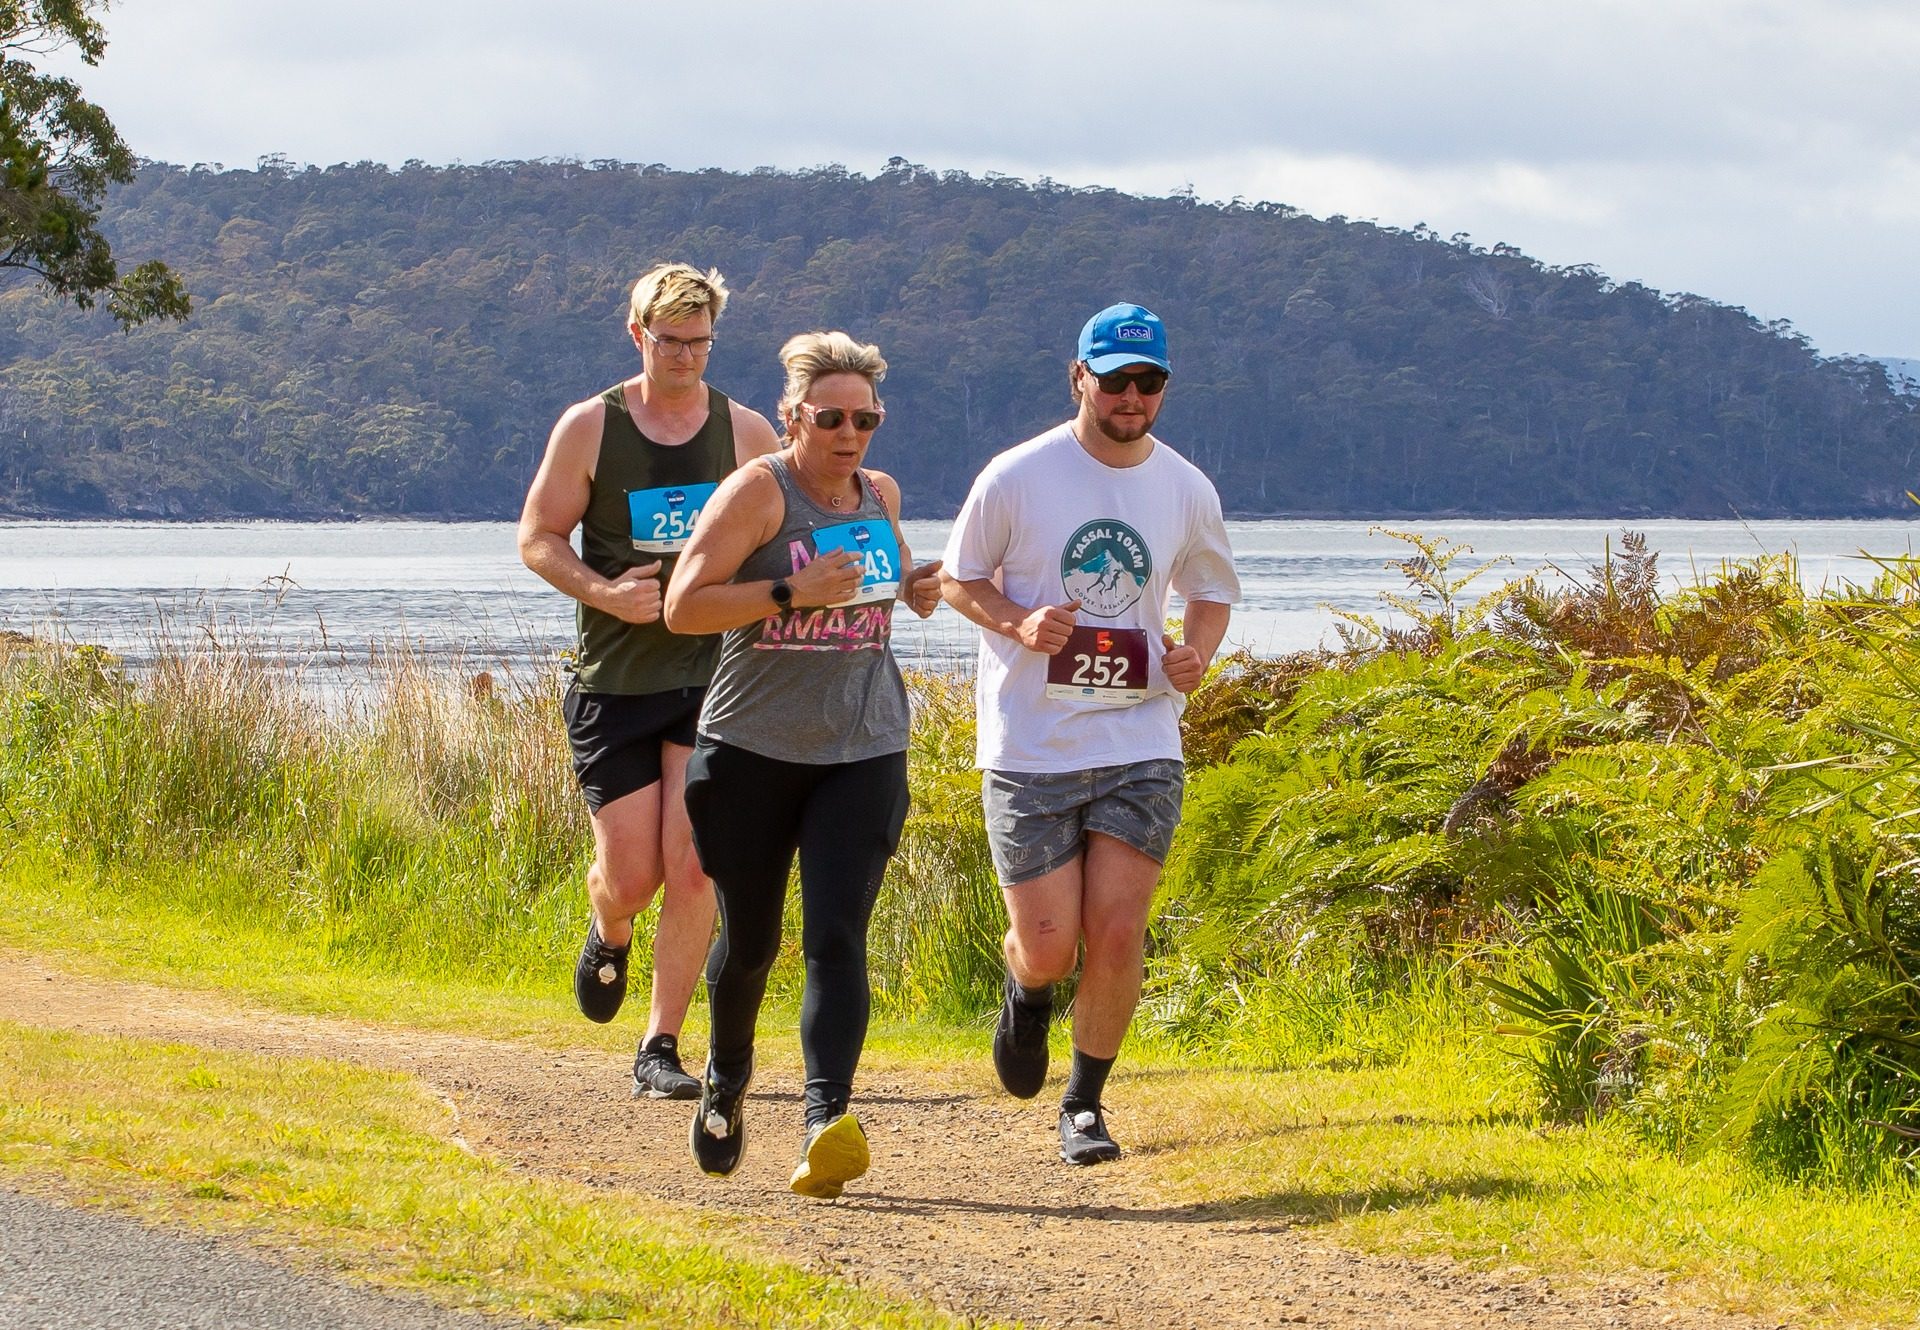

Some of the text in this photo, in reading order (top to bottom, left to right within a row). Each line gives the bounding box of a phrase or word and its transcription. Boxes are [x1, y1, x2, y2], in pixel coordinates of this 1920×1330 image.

[1117, 327, 1151, 339] tassal
[652, 509, 701, 539] 254
[1072, 528, 1144, 569] TASSAL 10KM
[853, 549, 893, 581] 43
[1072, 654, 1129, 687] 252
